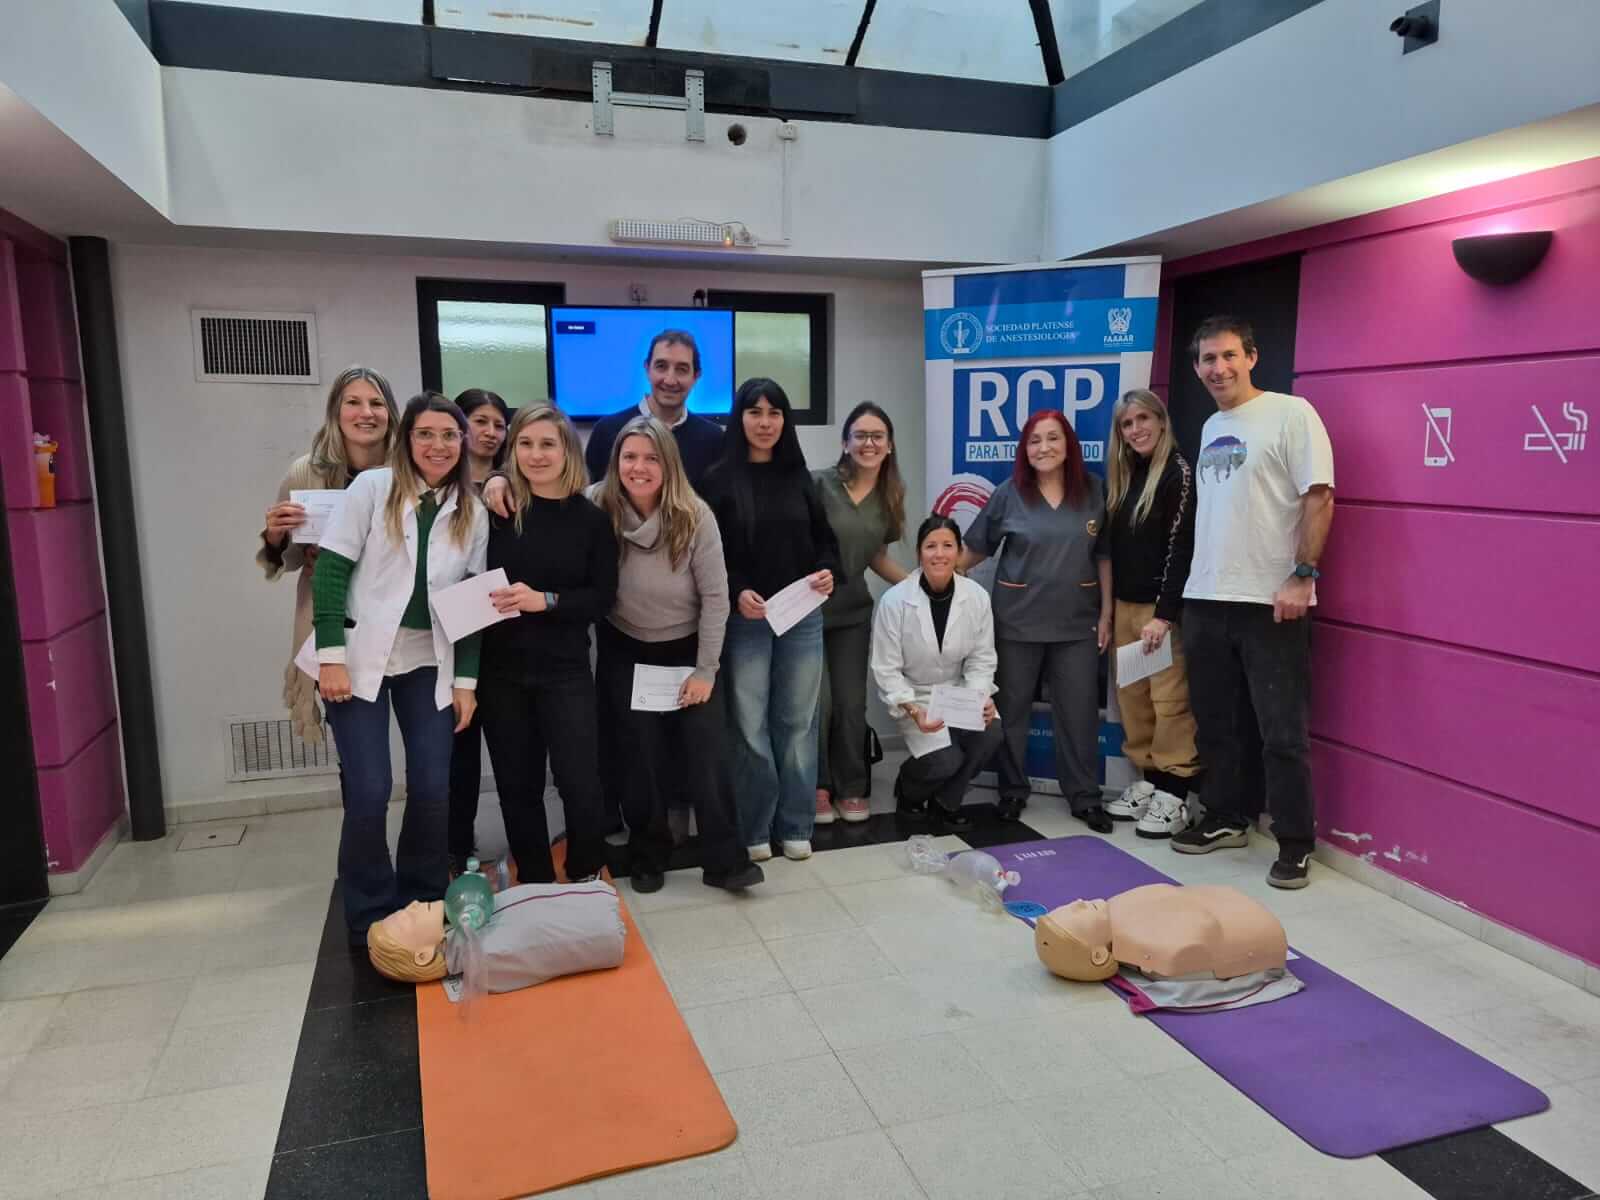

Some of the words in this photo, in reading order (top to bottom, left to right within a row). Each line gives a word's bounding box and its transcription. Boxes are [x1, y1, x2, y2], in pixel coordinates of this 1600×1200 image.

[985, 323, 1030, 334] SOCIEDAD
[1031, 320, 1074, 330] PLATENSE
[985, 335, 998, 343] DE
[968, 368, 1104, 437] RCP
[968, 444, 999, 460] PARA
